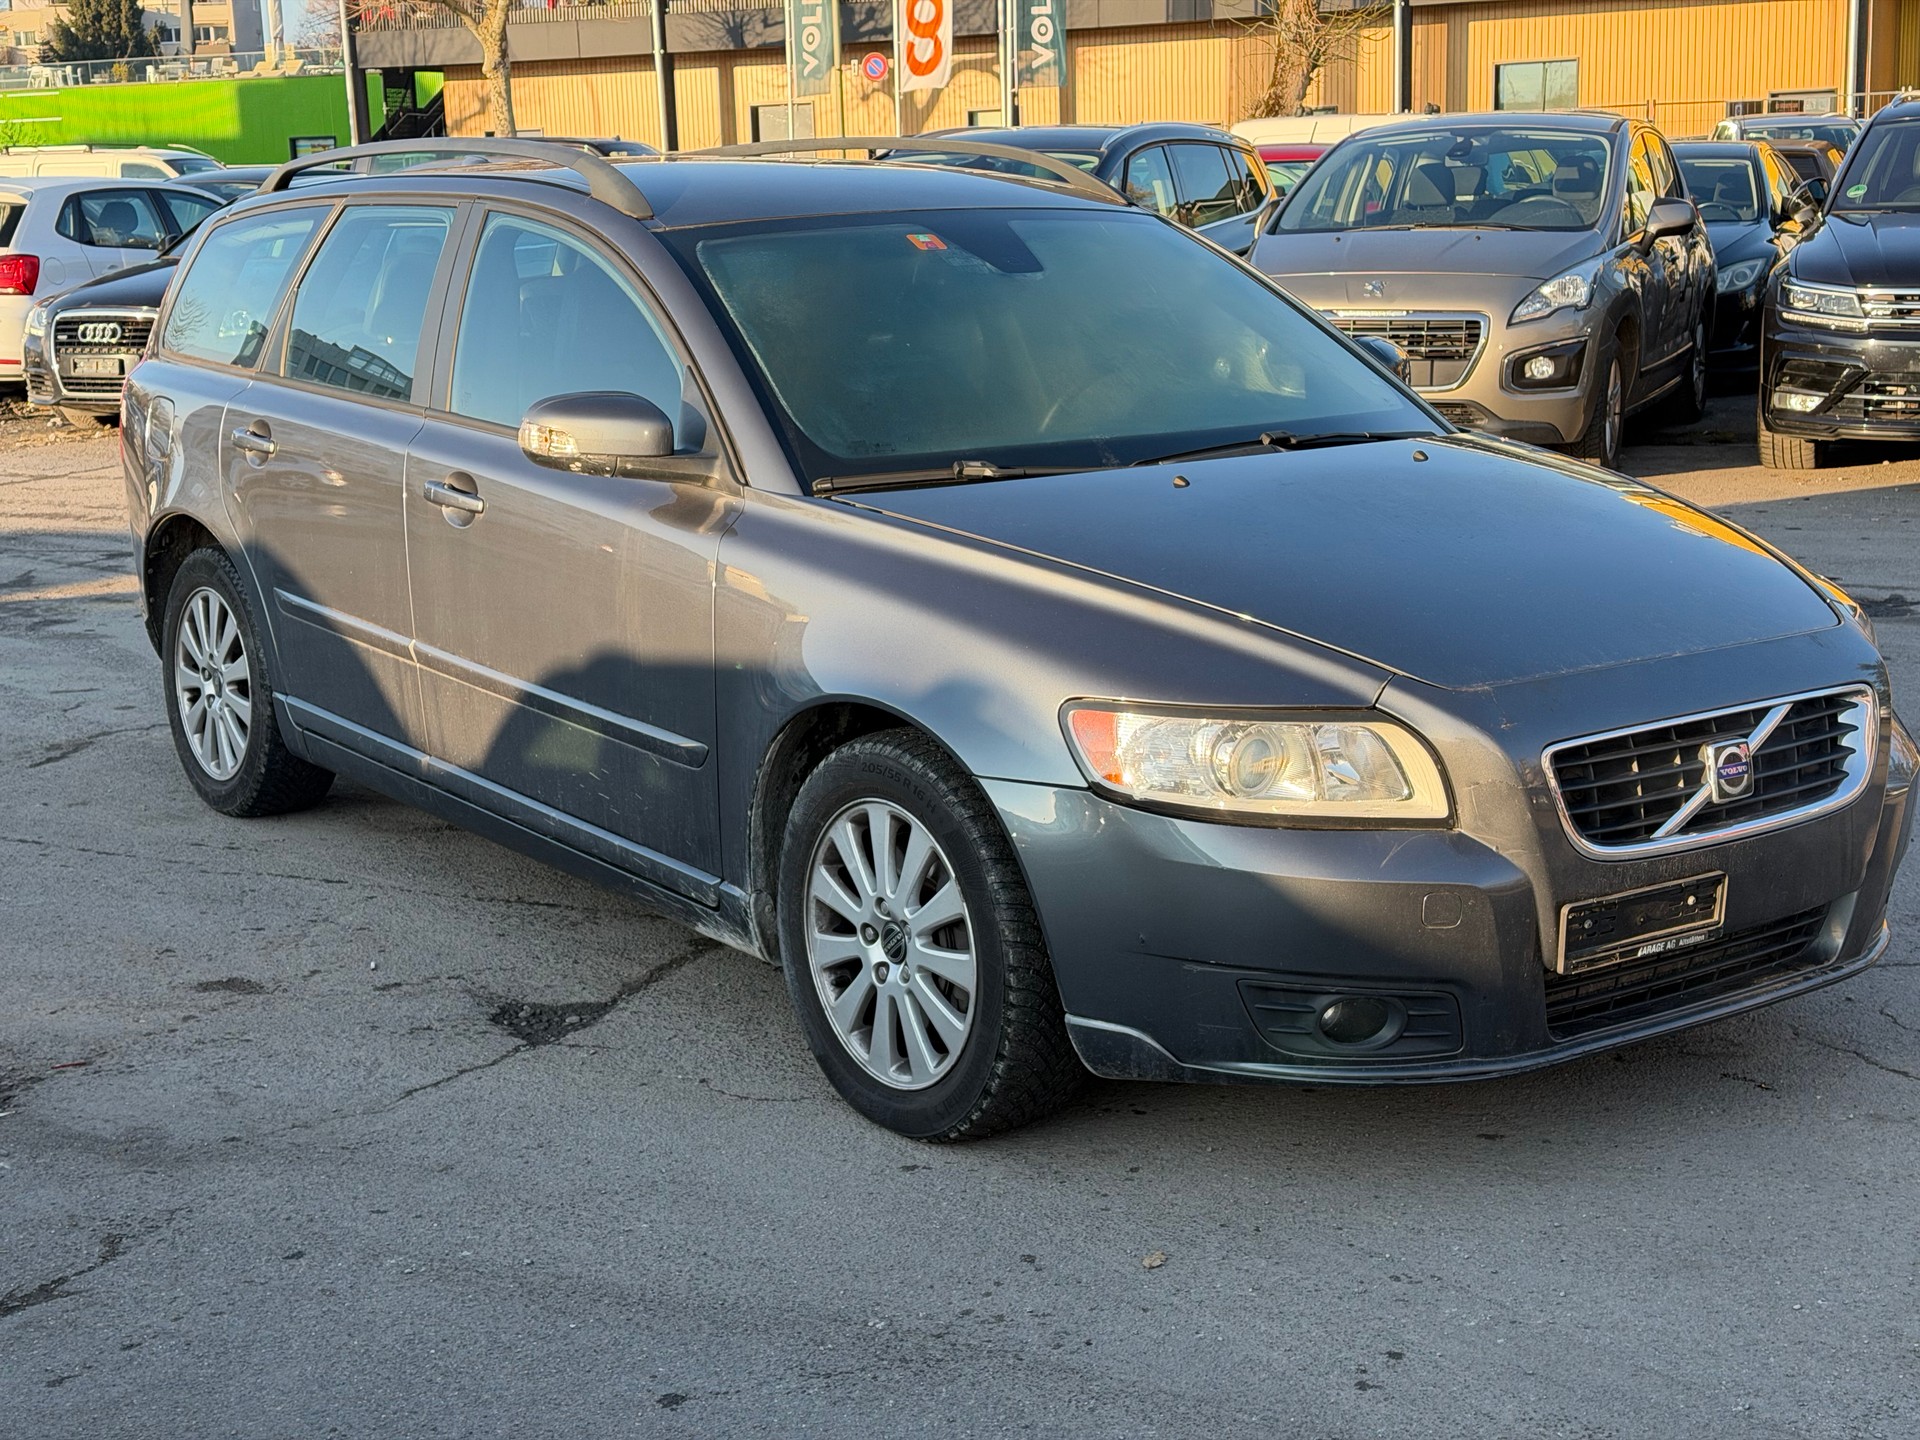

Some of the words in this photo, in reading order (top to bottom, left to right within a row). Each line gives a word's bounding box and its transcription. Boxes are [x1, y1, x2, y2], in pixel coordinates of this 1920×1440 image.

[1720, 765, 1748, 776] VOLVO
[861, 761, 902, 783] 205/55
[902, 778, 912, 792] R
[912, 785, 926, 802] 16
[1666, 939, 1676, 950] AG
